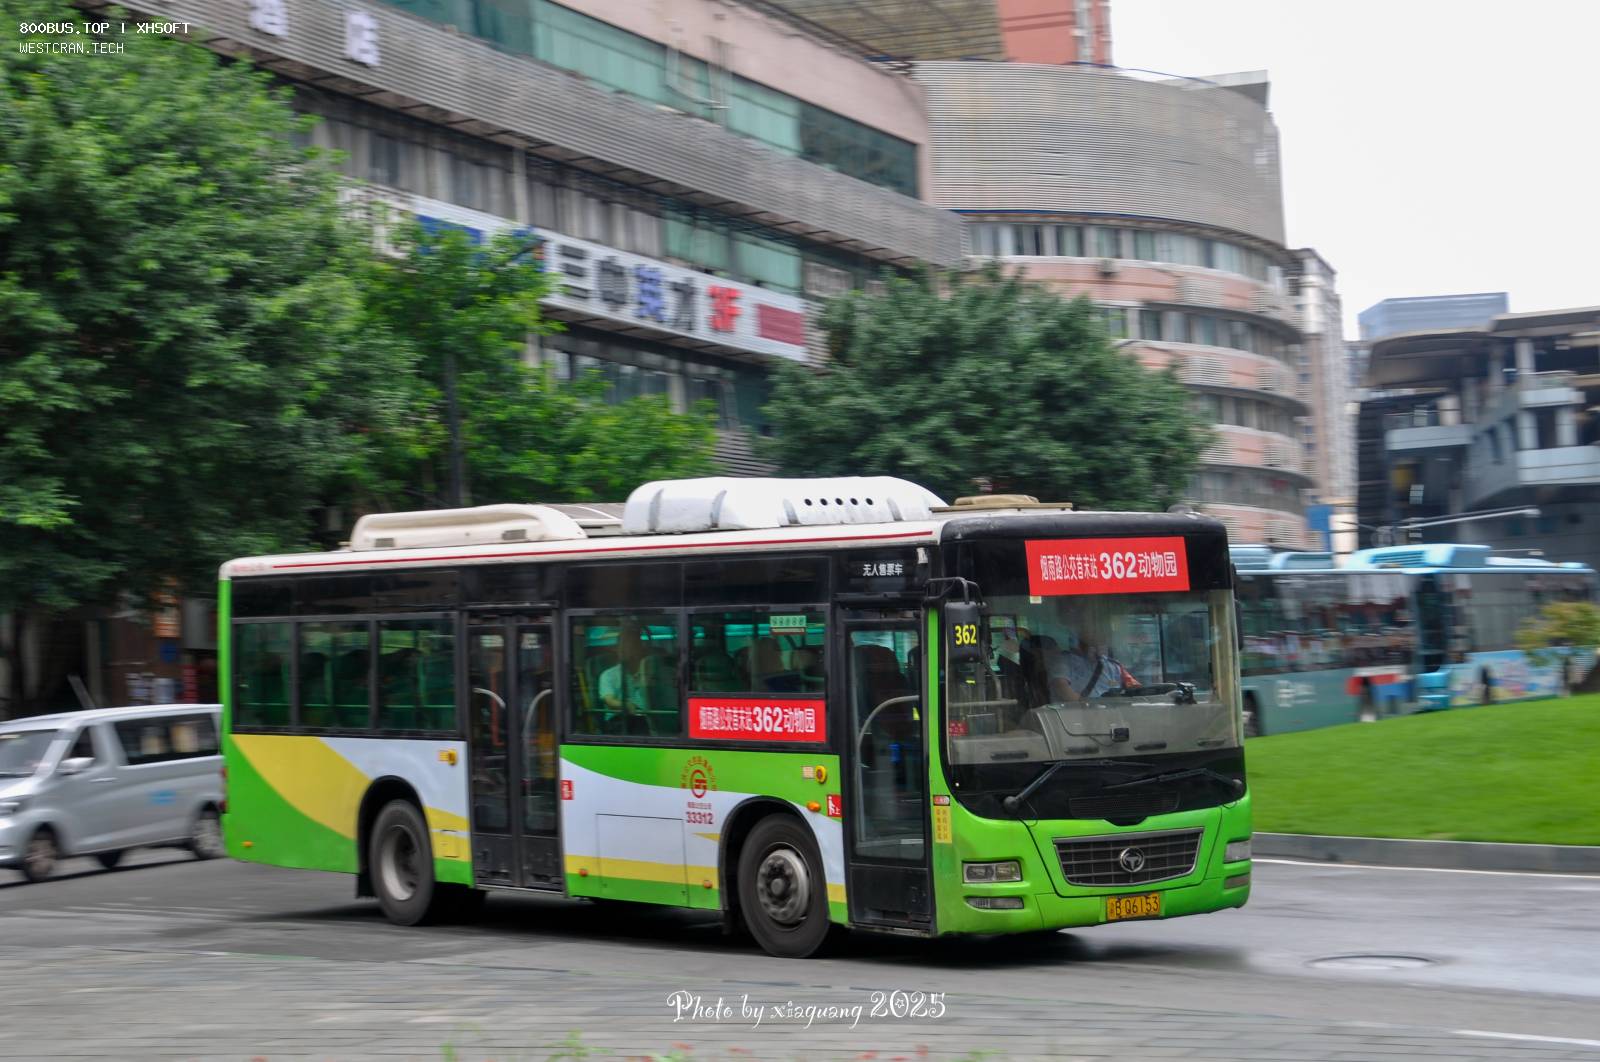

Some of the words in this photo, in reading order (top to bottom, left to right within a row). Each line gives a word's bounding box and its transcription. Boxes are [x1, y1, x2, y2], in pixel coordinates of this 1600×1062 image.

[863, 563, 903, 576] 无人售票车
[1100, 552, 1137, 579] 362
[1138, 551, 1178, 577] 动物园
[955, 624, 977, 646] 362
[753, 706, 783, 732] 362
[686, 811, 713, 824] 33312
